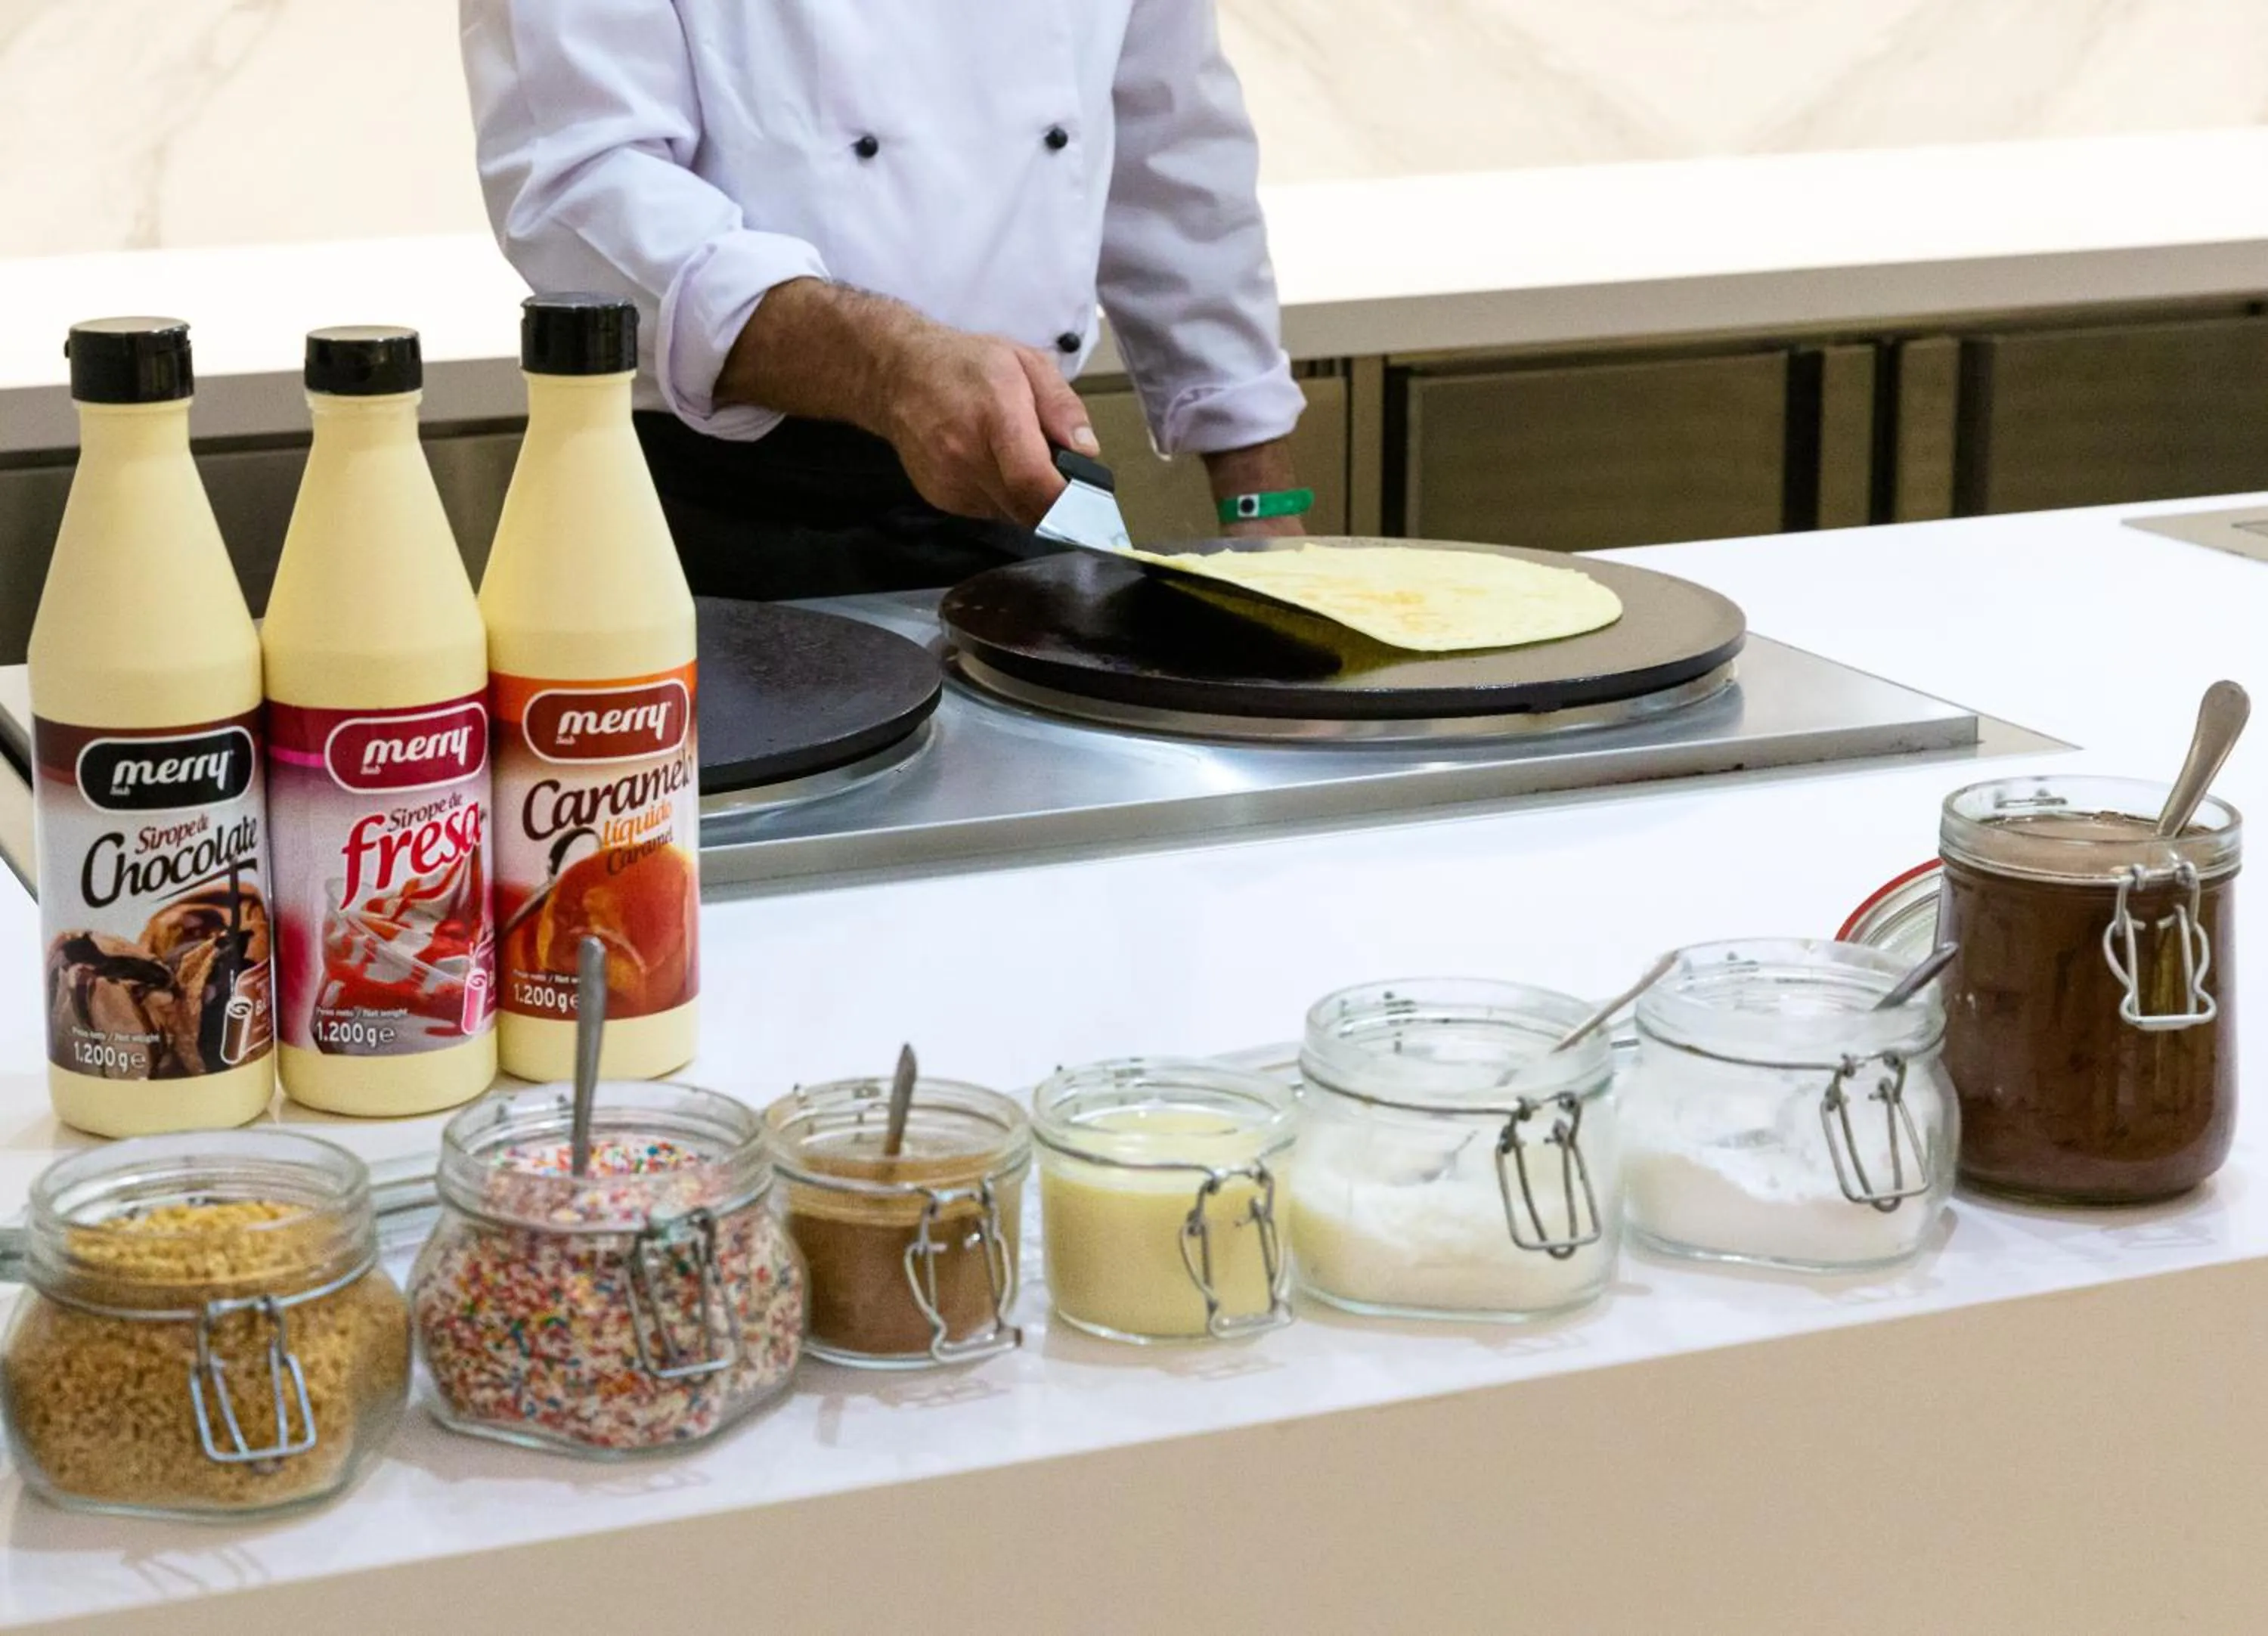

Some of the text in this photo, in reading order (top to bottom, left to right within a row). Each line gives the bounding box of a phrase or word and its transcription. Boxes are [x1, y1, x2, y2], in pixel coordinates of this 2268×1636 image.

[558, 702, 670, 740] merry
[361, 726, 470, 766] merry
[113, 750, 230, 791] merry
[387, 798, 446, 832] Sirope
[135, 819, 195, 855] Sirope
[81, 815, 258, 909] Chocolate
